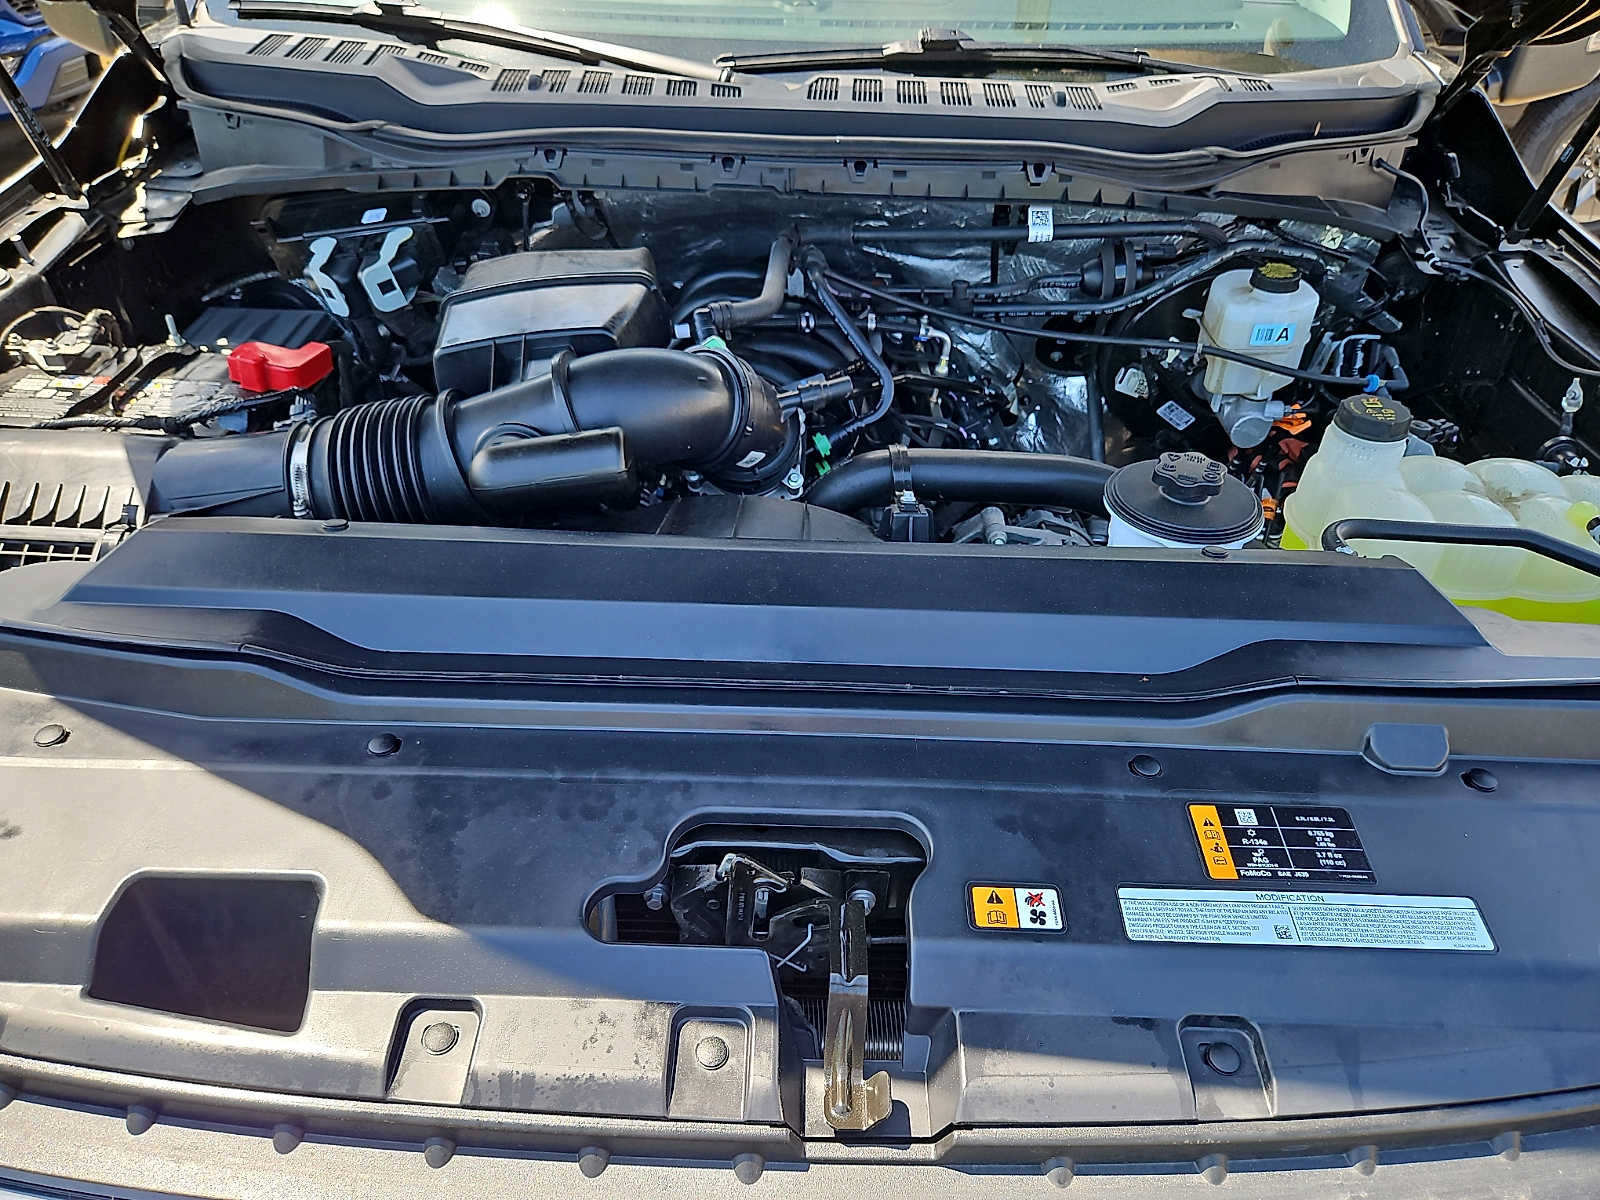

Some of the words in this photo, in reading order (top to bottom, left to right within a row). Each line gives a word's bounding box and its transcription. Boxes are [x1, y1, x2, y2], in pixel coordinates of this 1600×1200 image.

[1275, 327, 1289, 342] A
[1252, 856, 1270, 864] PAG
[1239, 869, 1272, 877] FoMoCo
[1255, 893, 1326, 903] MODIFICATION
